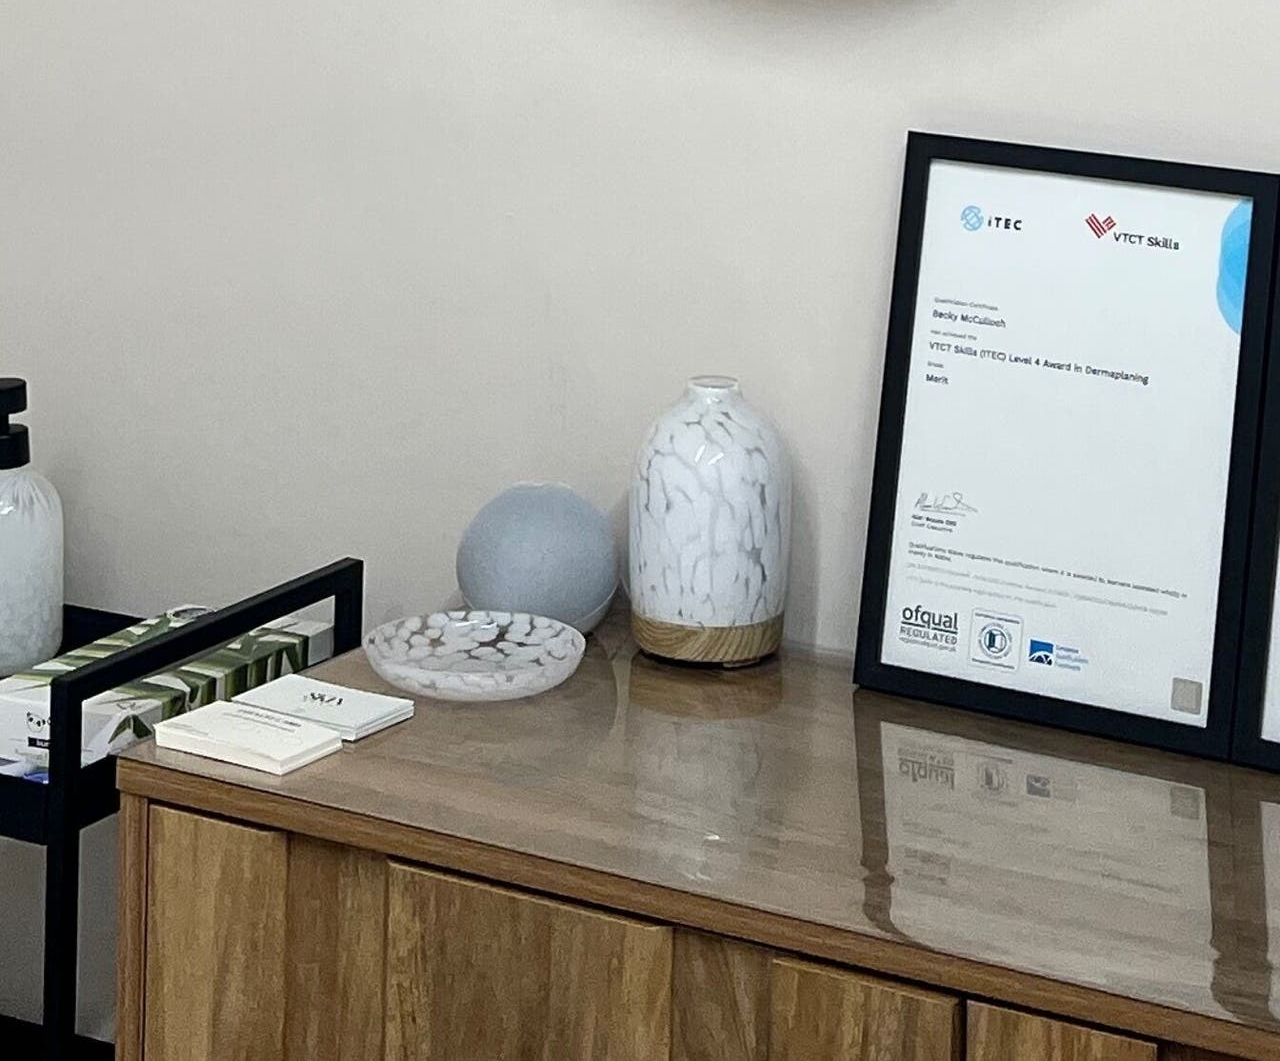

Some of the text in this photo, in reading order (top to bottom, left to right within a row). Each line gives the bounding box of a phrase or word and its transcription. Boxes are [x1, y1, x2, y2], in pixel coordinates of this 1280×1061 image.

[987, 217, 1023, 231] iTEC
[1113, 232, 1179, 251] VTCT Skills
[929, 341, 952, 353] VTCT
[954, 345, 978, 357] Skills
[1009, 353, 1033, 366] Level
[1034, 357, 1041, 366] 4
[1043, 359, 1072, 372] Award
[1074, 363, 1083, 373] in
[1085, 365, 1150, 386] Dermaplaning
[926, 373, 950, 386] Merit
[901, 604, 959, 631] ofqual
[899, 625, 959, 646] REGULATED
